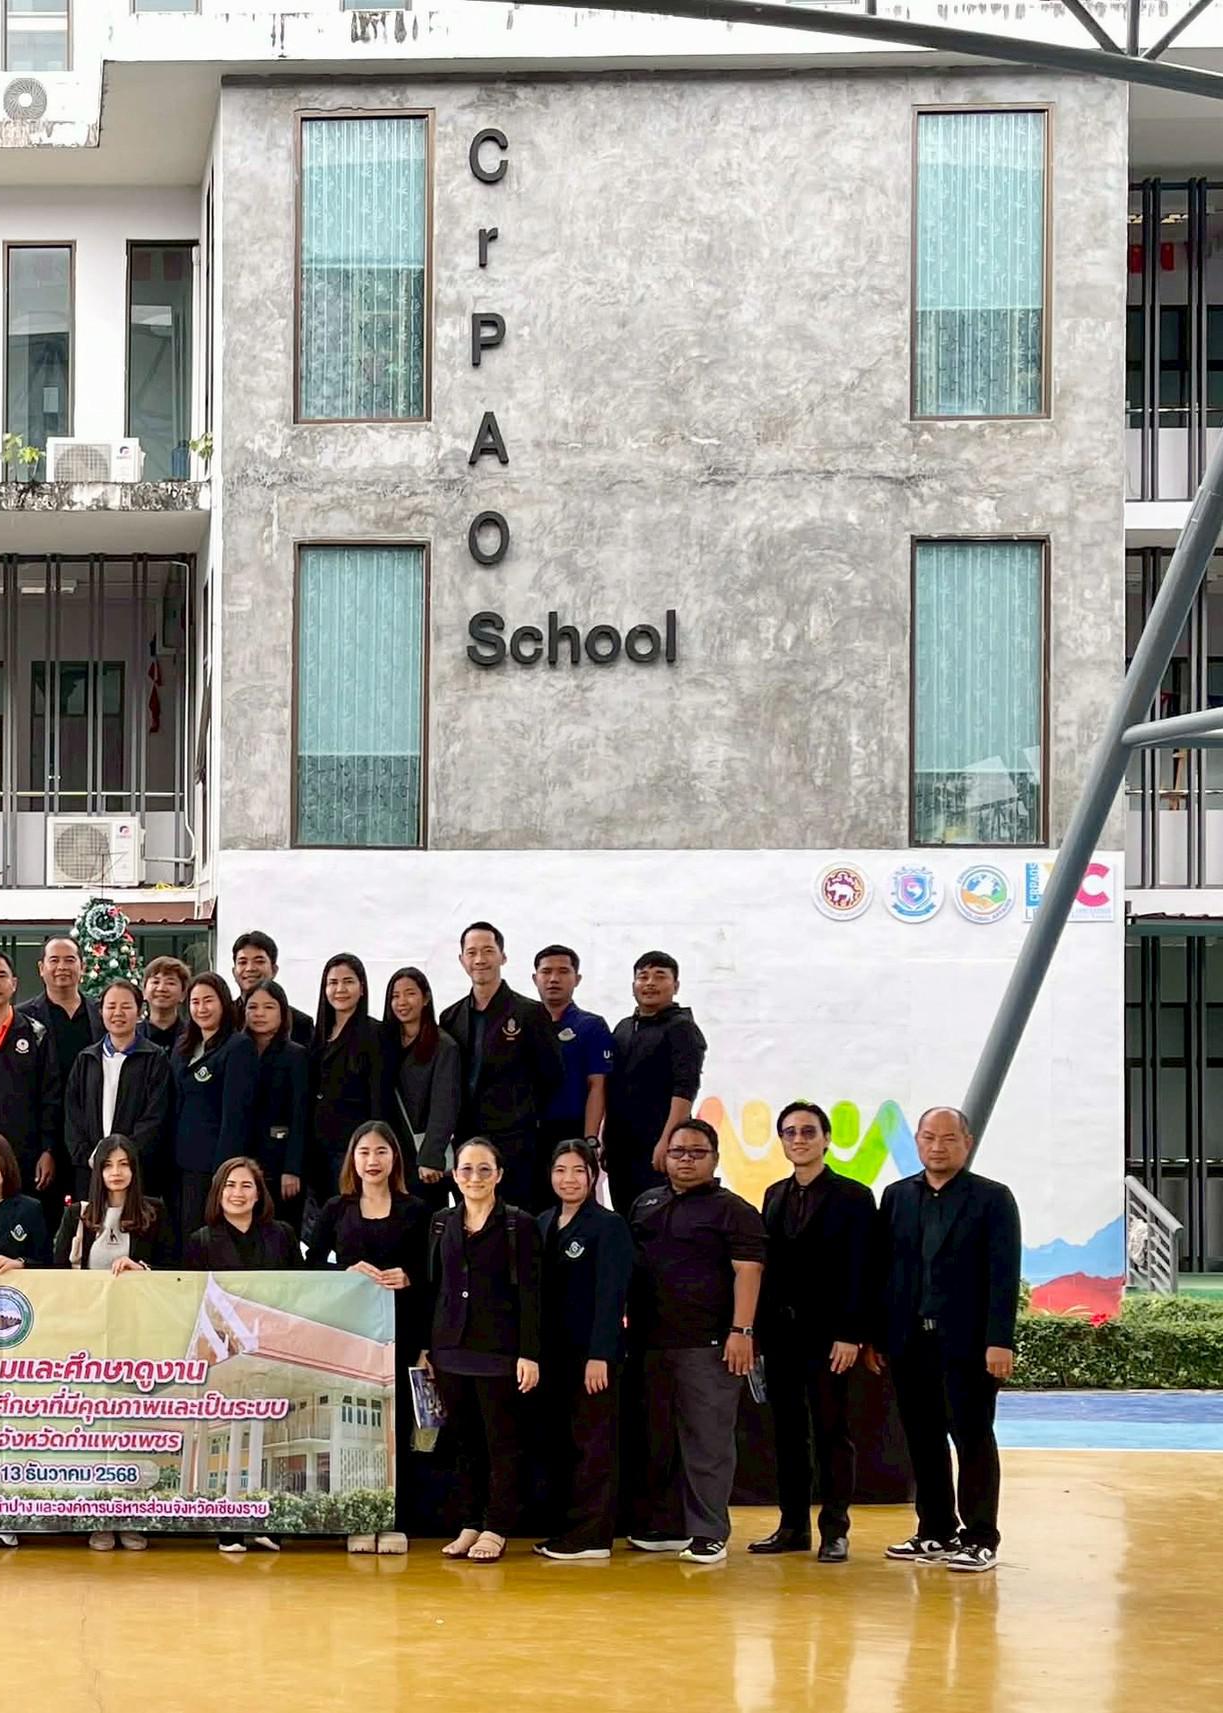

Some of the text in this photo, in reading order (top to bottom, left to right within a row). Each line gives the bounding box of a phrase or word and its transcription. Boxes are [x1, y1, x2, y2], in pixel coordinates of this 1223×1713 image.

[467, 609, 677, 668] School
[1, 1464, 21, 1482] 13
[25, 1462, 91, 1483] ธันวาคม
[96, 1465, 138, 1483] 2568
[35, 1495, 267, 1515] และองค์การบริหารส่วนจังหวัดเชียงราย
